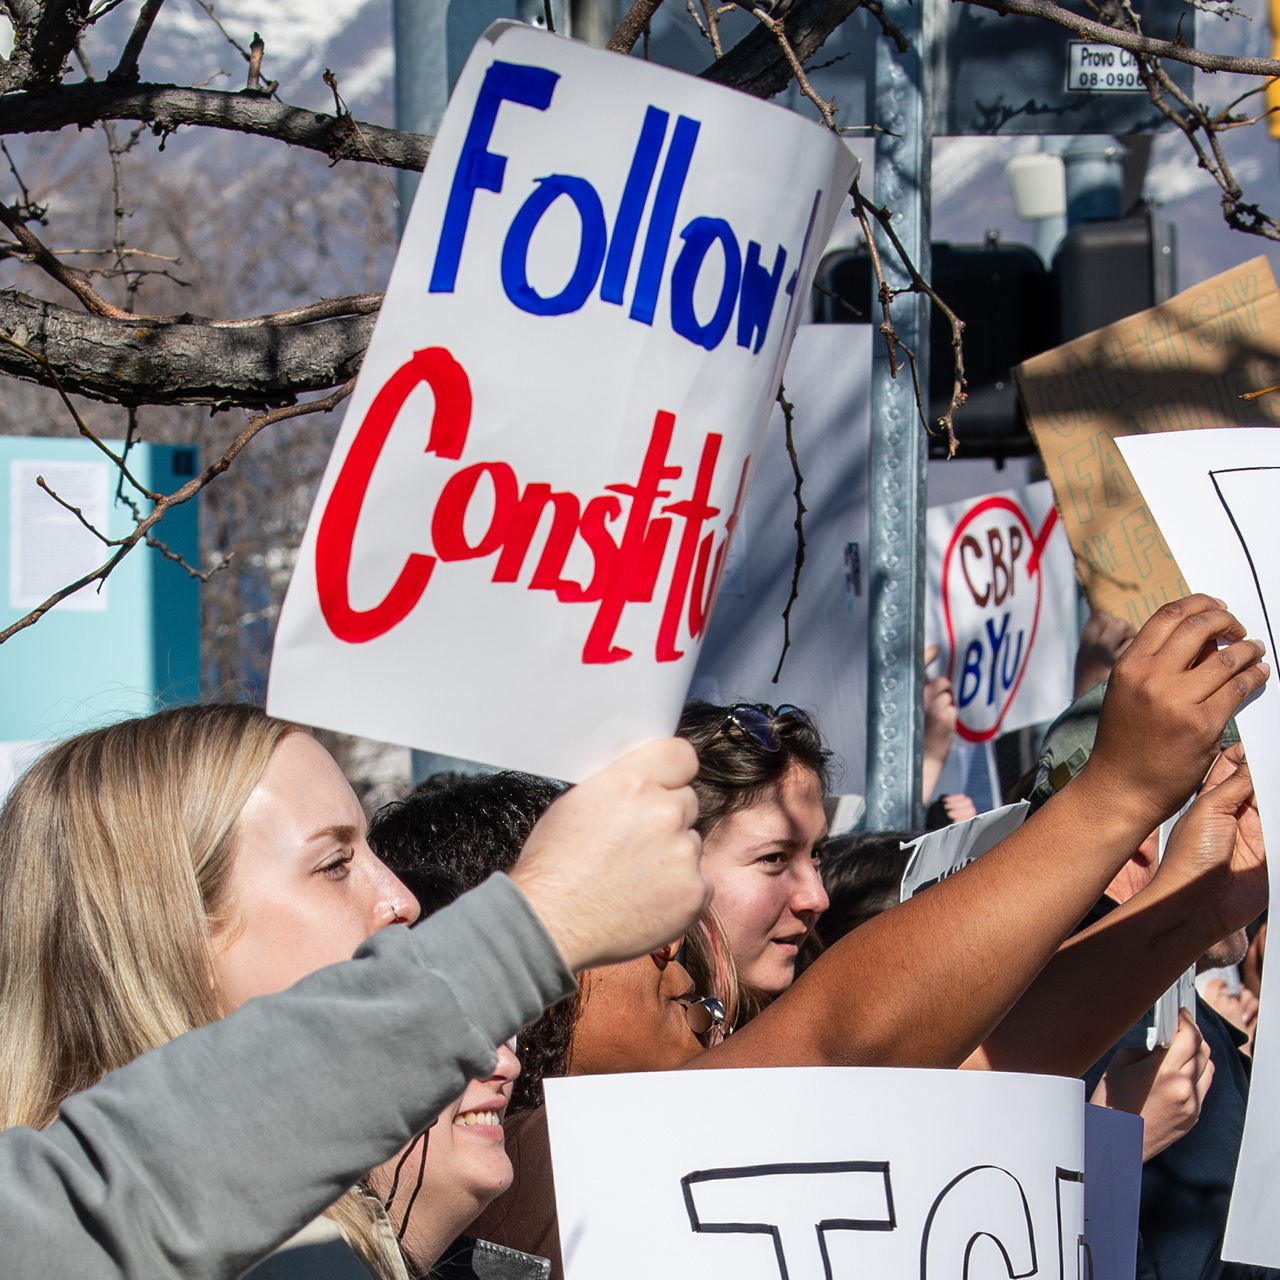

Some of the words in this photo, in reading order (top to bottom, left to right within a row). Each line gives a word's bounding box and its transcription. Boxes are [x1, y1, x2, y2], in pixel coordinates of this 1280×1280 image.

[1081, 47, 1115, 67] Provo
[429, 60, 787, 355] Follow
[1188, 274, 1261, 355] SAY
[959, 526, 1023, 608] CBP
[958, 613, 1024, 709] BYU
